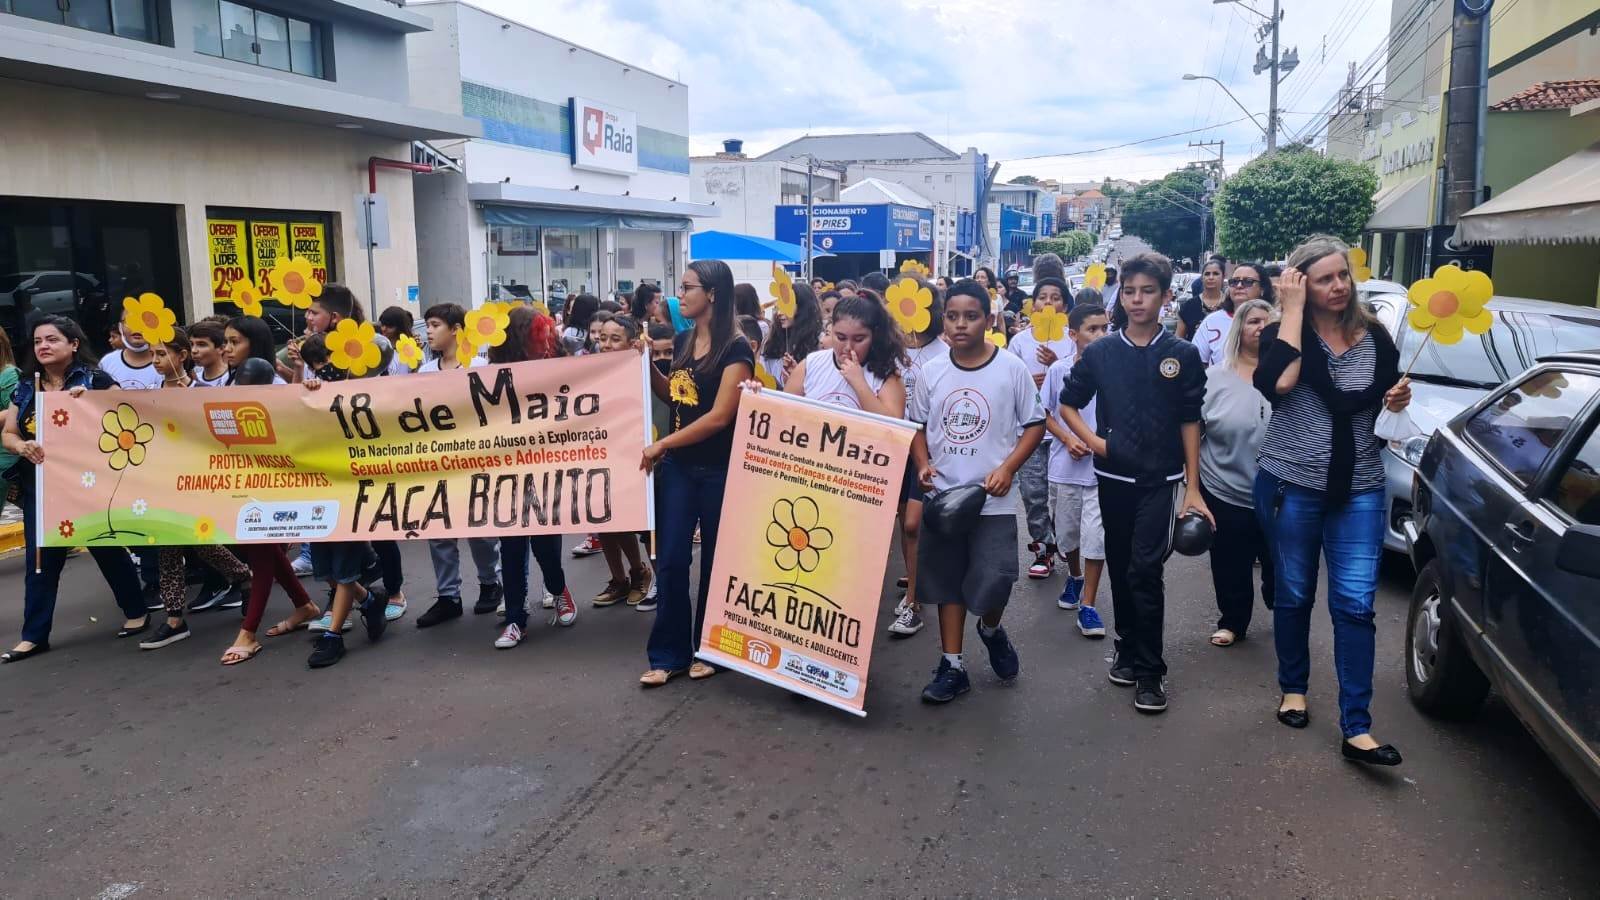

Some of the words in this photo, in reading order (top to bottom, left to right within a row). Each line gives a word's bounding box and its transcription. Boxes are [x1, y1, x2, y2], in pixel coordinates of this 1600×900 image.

[604, 123, 633, 154] Raia
[793, 207, 868, 216] ESTCIONAMENTO
[209, 223, 238, 238] OFERTA
[253, 224, 280, 239] OFERTA
[293, 226, 317, 238] OFERTA
[822, 218, 848, 228] PIRES
[257, 248, 276, 259] CLUB
[294, 239, 320, 252] ARROZ
[213, 253, 238, 266] LIDER
[329, 392, 382, 440] 18
[398, 397, 457, 433] de
[467, 367, 600, 427] Maio
[209, 409, 234, 420] DISQUE
[239, 419, 268, 438] 100
[748, 409, 771, 440] 18
[779, 425, 809, 448] de
[819, 421, 890, 467] Maio
[348, 446, 366, 459] Dia
[368, 442, 413, 457] Nacional
[415, 441, 428, 454] de
[430, 438, 476, 453] Combate
[478, 440, 491, 450] ao
[493, 435, 527, 448] Abuso
[528, 434, 536, 445] e
[538, 431, 546, 444] à
[547, 427, 608, 446] Exploração
[209, 454, 254, 470] PROTEJA
[253, 454, 296, 469] NOSSAS
[350, 459, 393, 477] Sexual
[395, 458, 438, 473] contra
[440, 455, 501, 472] Crianças
[504, 454, 513, 466] e
[515, 445, 608, 466] Adolescentes
[746, 442, 756, 451] Dia
[756, 445, 781, 457] Nacional
[781, 450, 789, 459] de
[789, 453, 815, 467] Combate
[815, 461, 824, 469] ao
[824, 462, 843, 474] Abuso
[853, 470, 888, 486] Exploração
[176, 474, 232, 493] CRIANÇAS
[235, 473, 242, 489] E
[244, 472, 333, 489] ADOLESCENTES.
[744, 451, 771, 465] Sexual
[768, 460, 792, 473] contra
[793, 463, 825, 482] Crianças
[826, 474, 832, 482] e
[832, 475, 886, 496] Adolescentes
[743, 461, 773, 477] Esquecer
[773, 470, 779, 479] é
[779, 471, 809, 489] Permitir,
[809, 479, 840, 495] Lembrar
[840, 487, 846, 497] é
[846, 489, 884, 507] Combater
[351, 478, 453, 539] FAÇA
[467, 467, 612, 528] BONITO
[725, 575, 777, 620] FAÇA
[784, 595, 861, 648] BONITO
[723, 609, 748, 627] PROTEJA
[748, 618, 773, 635] NOSSAS
[773, 627, 804, 646] CRIANÇAS
[804, 638, 810, 649] E
[810, 639, 860, 667] ADOLESCENTES.
[748, 648, 770, 666] 100
